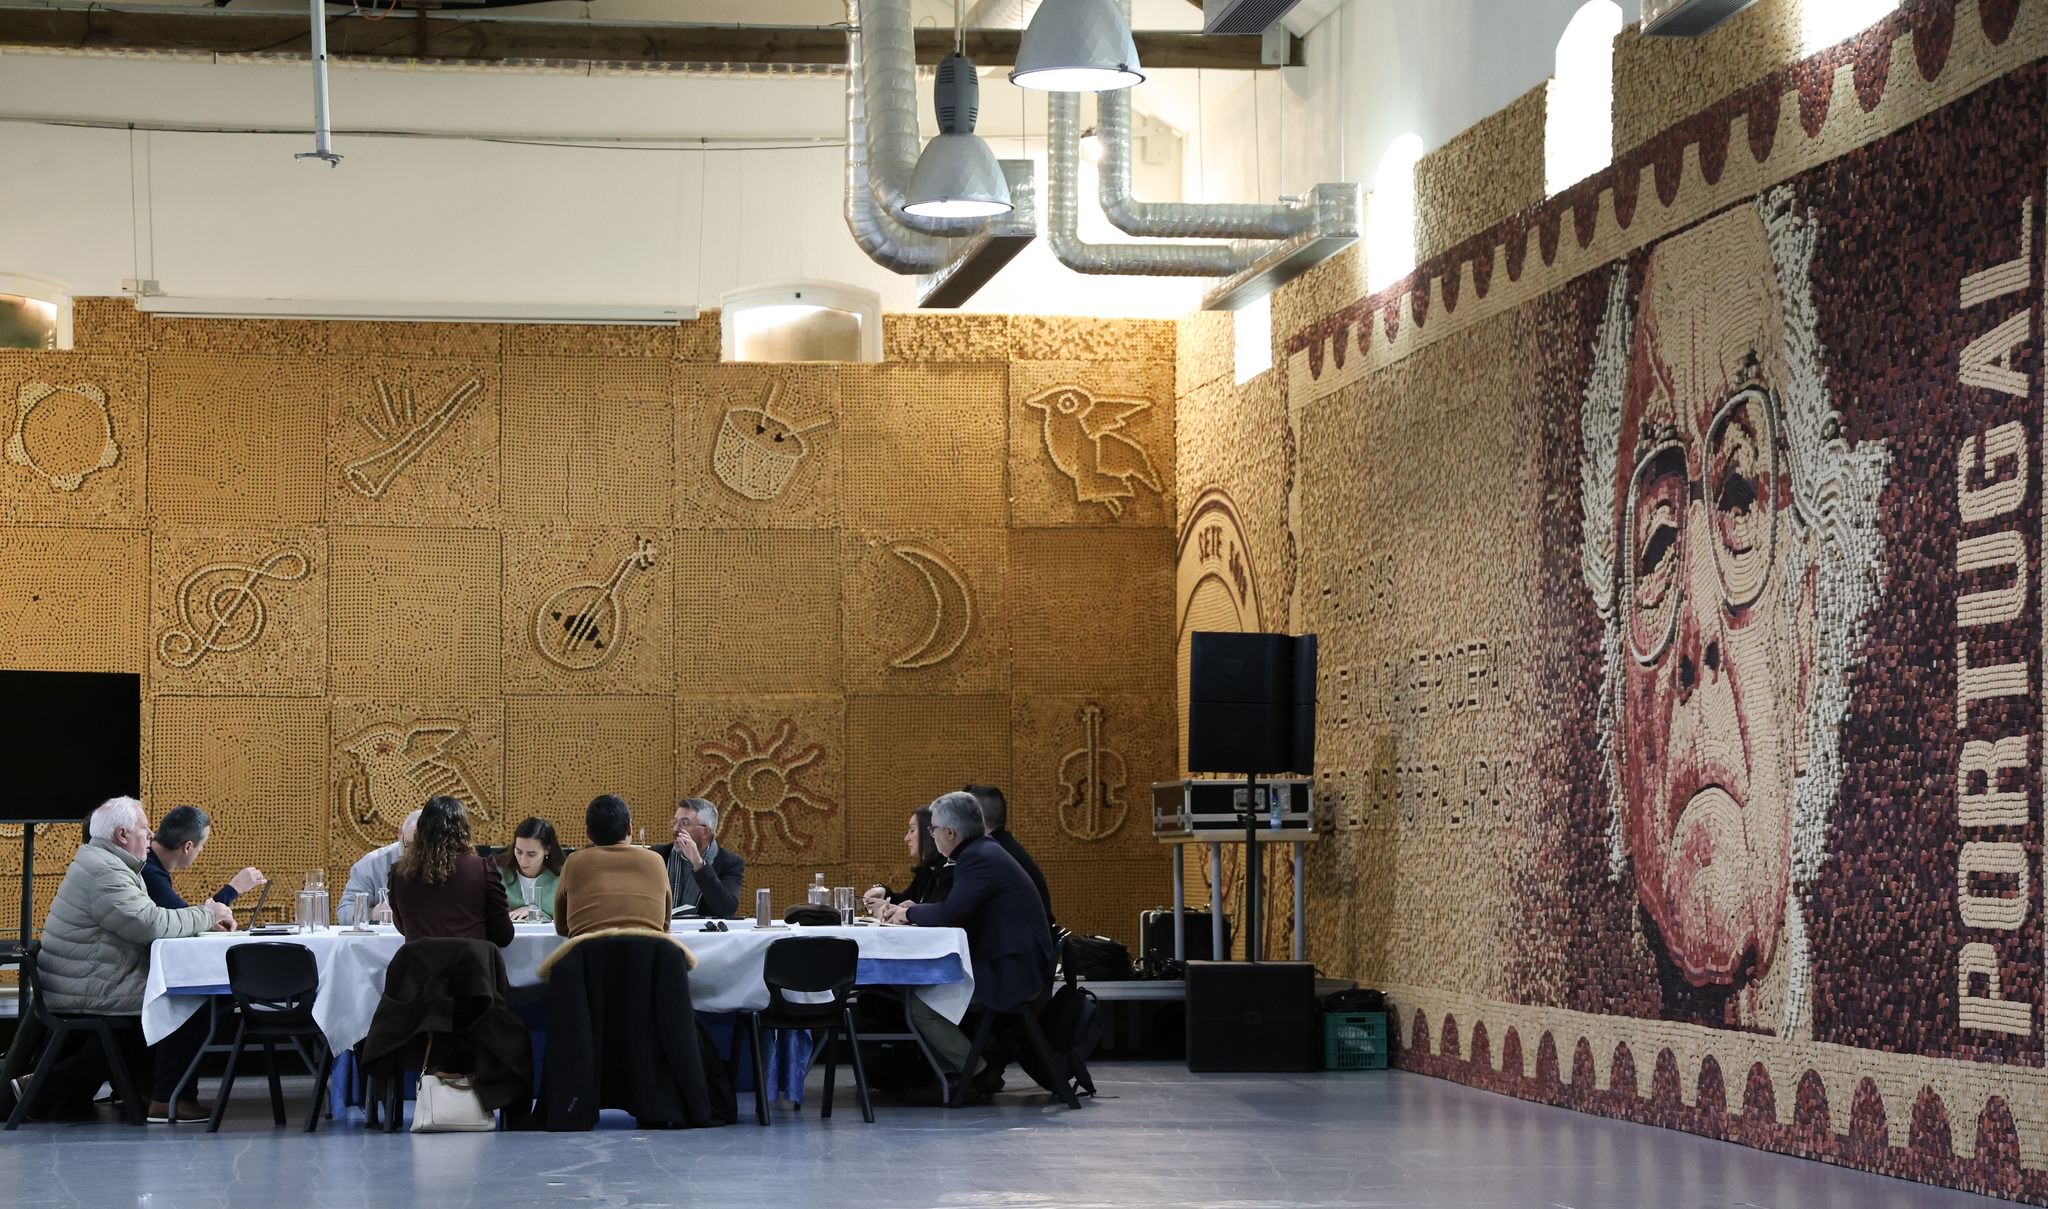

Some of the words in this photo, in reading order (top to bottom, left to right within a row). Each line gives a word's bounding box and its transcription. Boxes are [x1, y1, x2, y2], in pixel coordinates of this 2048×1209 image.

[1198, 523, 1223, 564] SETE
[1958, 195, 2033, 1037] PORTUGAL
[1407, 653, 1430, 719] SE
